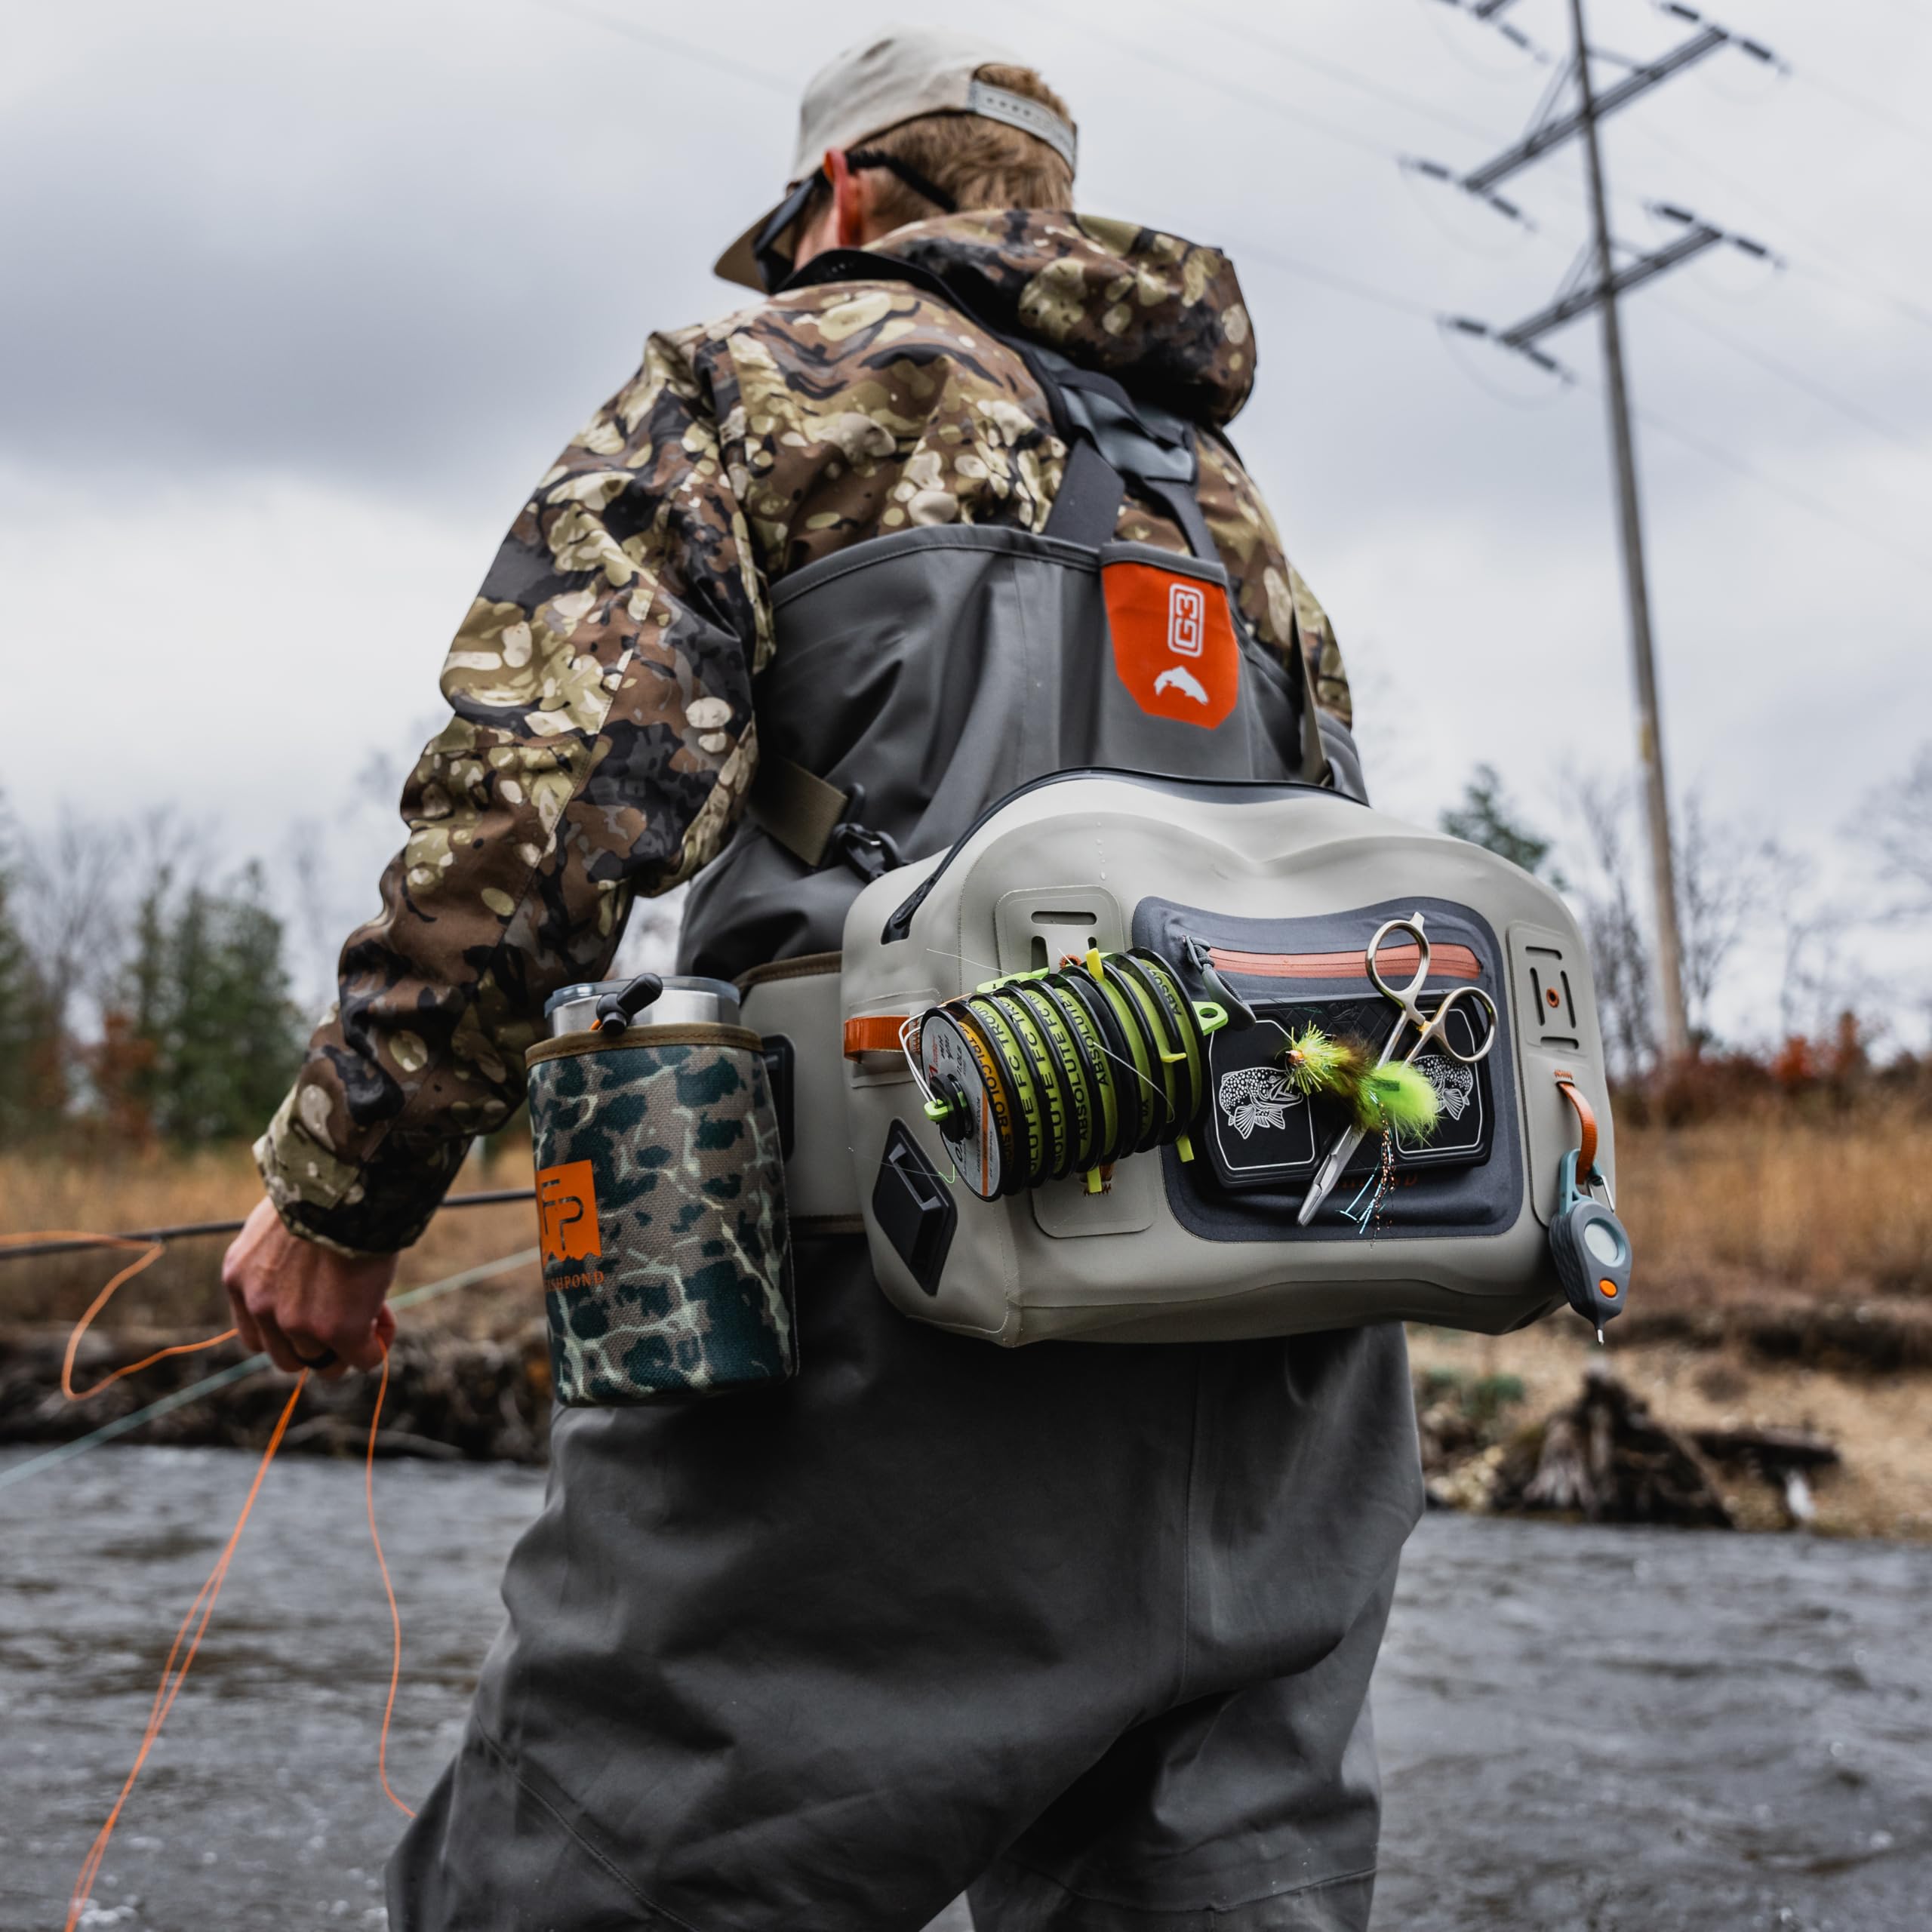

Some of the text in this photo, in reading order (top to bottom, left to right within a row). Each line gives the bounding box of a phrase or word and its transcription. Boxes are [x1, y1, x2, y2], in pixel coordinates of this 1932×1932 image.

[1175, 593, 1198, 649] G3
[1025, 1032, 1046, 1063] FC
[1009, 1054, 1027, 1088] FC
[1054, 1031, 1088, 1140] ABSOLUTE
